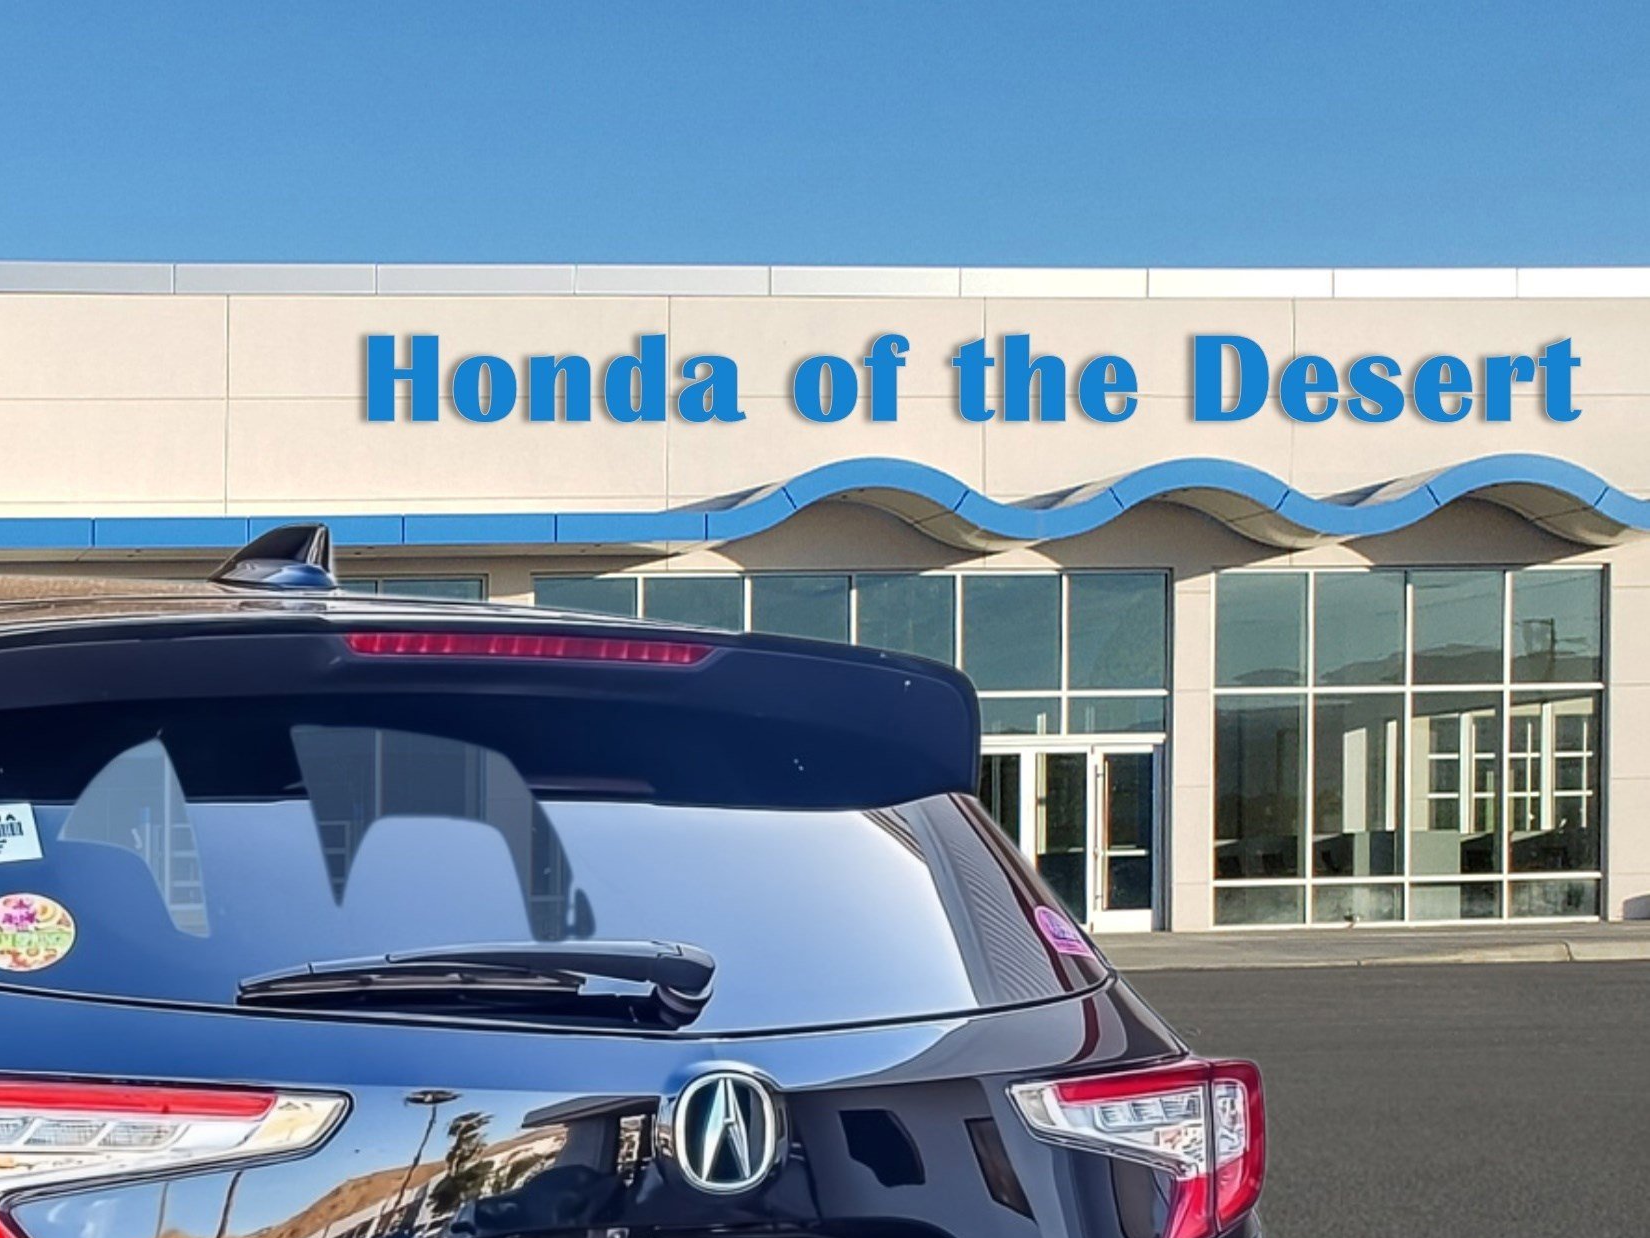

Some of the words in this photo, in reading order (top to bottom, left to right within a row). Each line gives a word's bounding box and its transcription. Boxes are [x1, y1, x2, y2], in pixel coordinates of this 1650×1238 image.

[366, 334, 747, 423] Honda
[793, 334, 910, 423] of
[953, 334, 1139, 423] the
[1193, 334, 1583, 423] Desert
